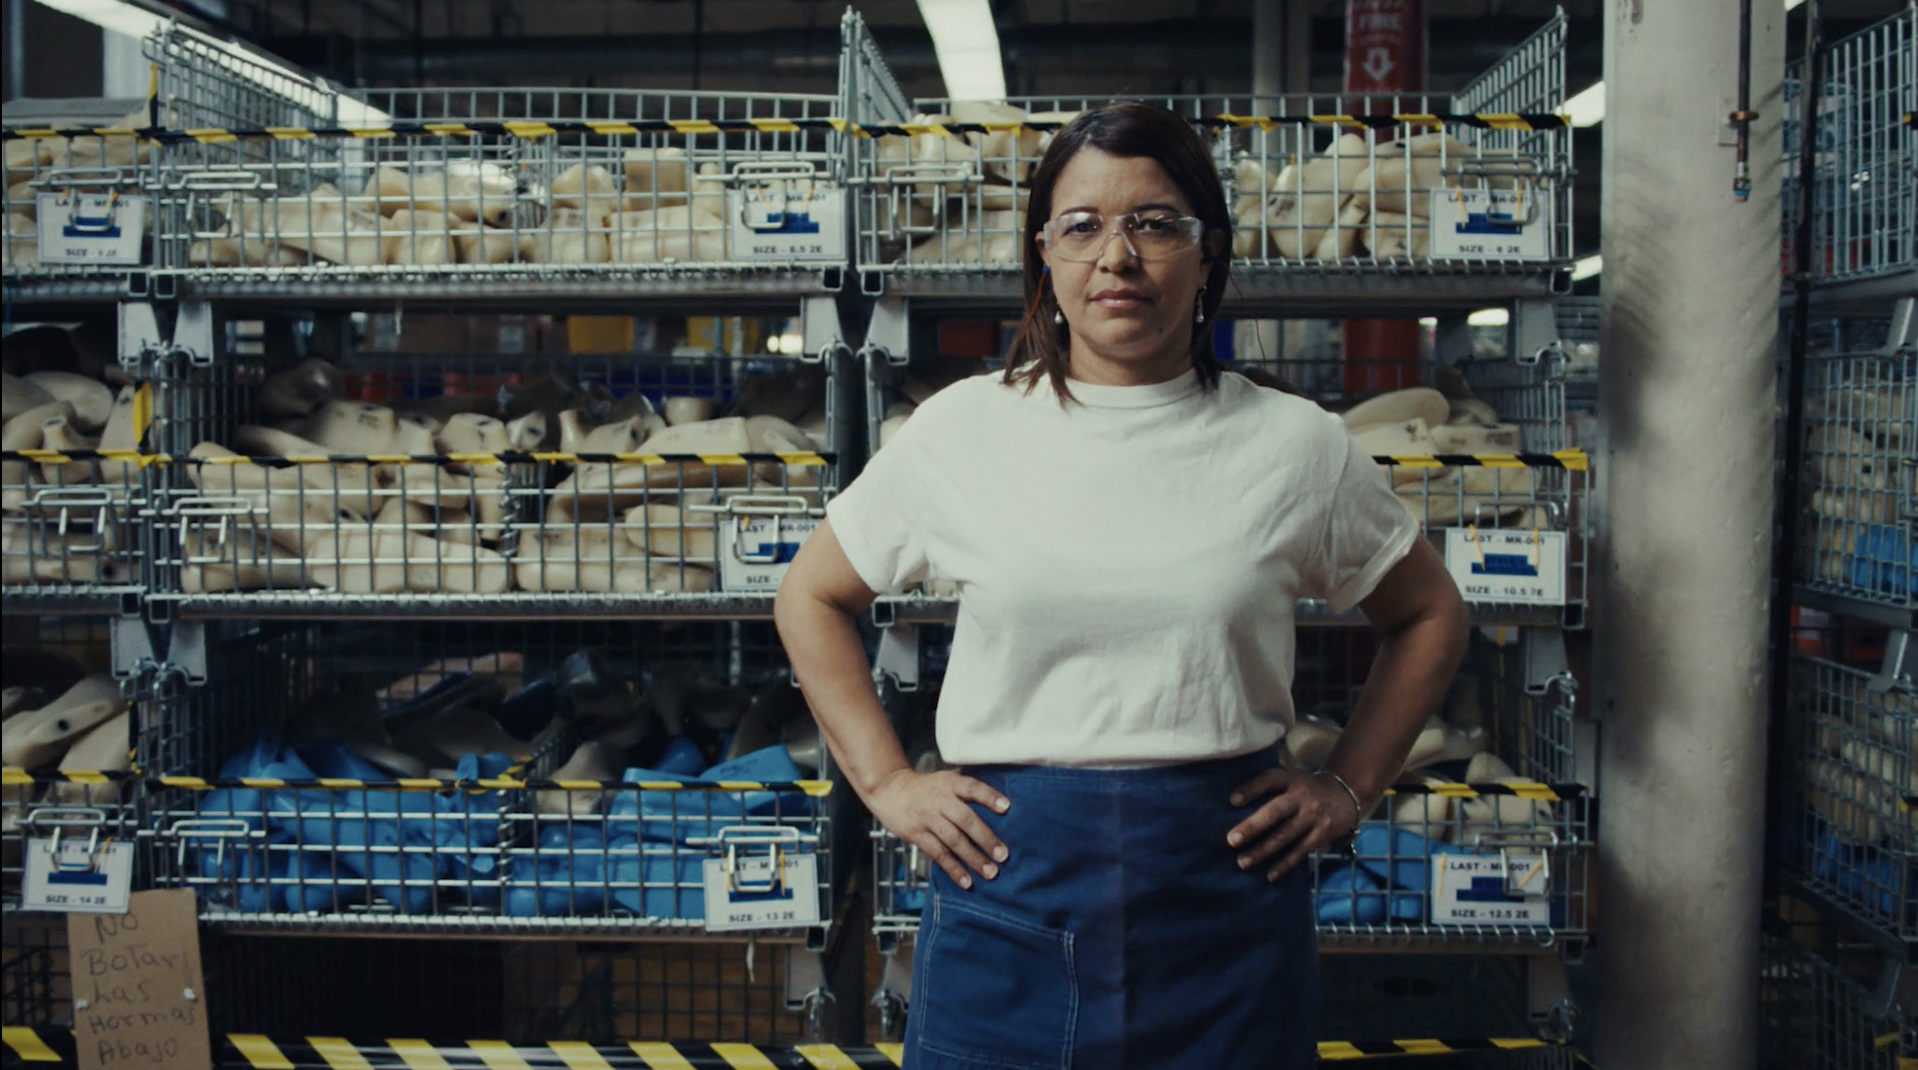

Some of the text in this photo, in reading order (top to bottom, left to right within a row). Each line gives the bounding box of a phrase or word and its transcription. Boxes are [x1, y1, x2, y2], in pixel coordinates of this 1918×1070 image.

[65, 248, 88, 257] SIZE
[753, 245, 777, 254] SIZE
[1458, 245, 1484, 253] SIZE
[746, 575, 771, 584] SIZE
[1465, 585, 1490, 594] SIZE
[1504, 586, 1527, 596] 10.5
[720, 862, 748, 872] LST
[1451, 862, 1479, 870] LAST
[46, 895, 68, 903] SIZE
[729, 914, 753, 922] SIZE
[1450, 909, 1476, 918] SIZE
[1515, 910, 1530, 919] 2E
